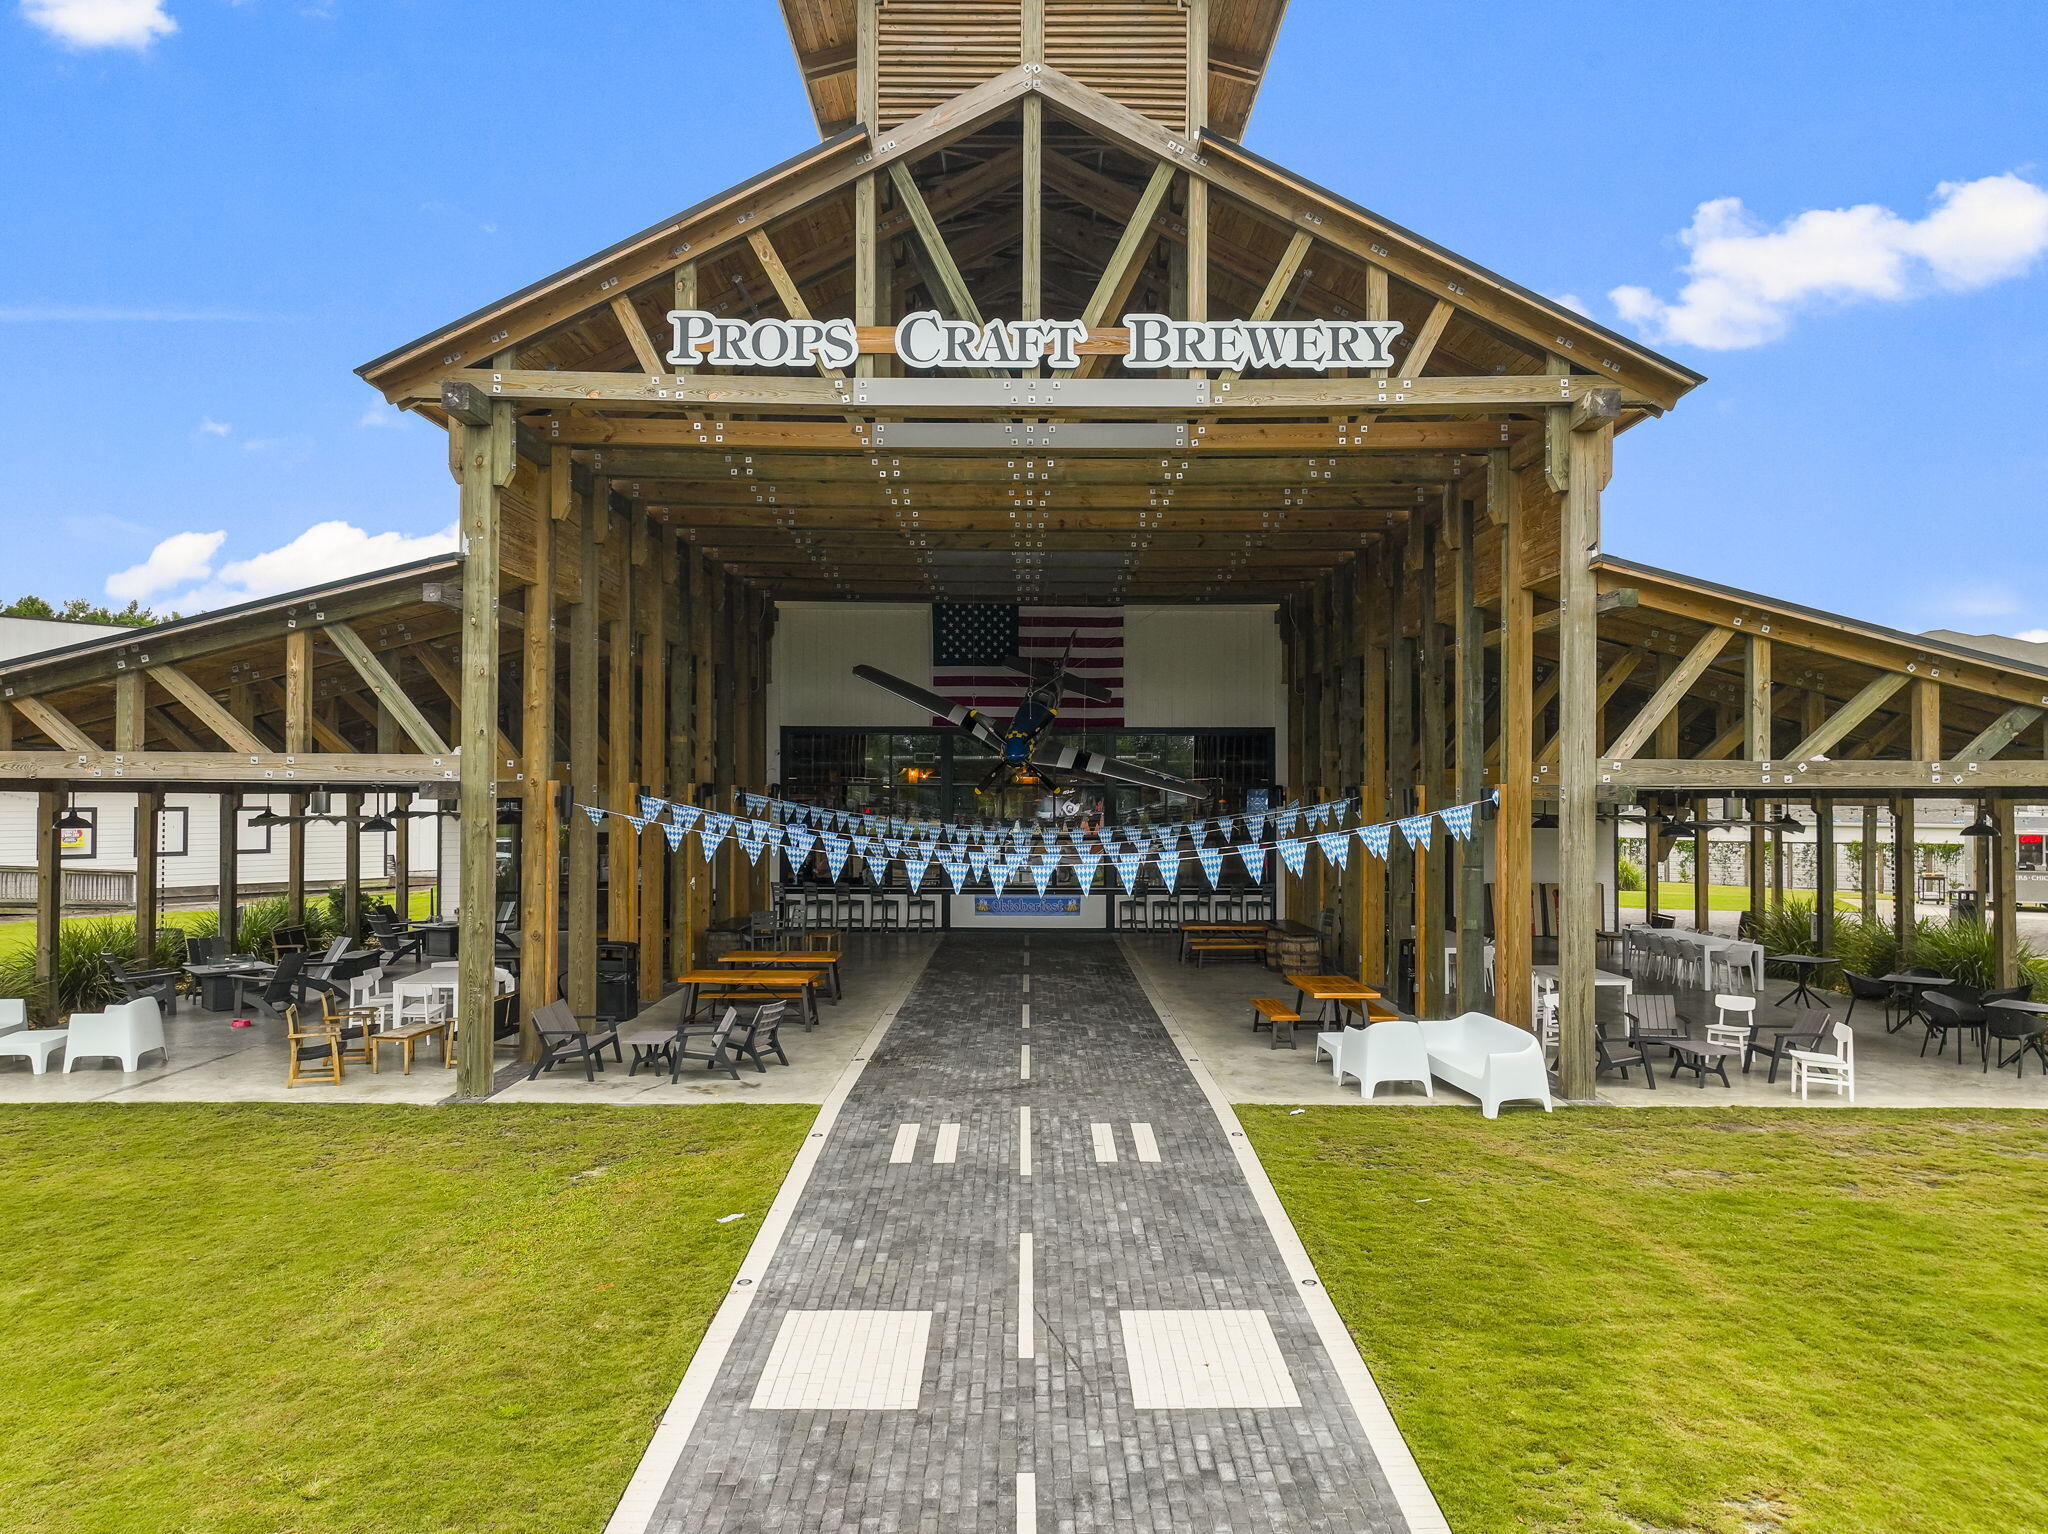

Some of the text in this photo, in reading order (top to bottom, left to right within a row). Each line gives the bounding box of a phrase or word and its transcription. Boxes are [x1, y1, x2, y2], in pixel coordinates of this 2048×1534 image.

[672, 316, 1398, 365] PROPS CRAFT BREWERY
[991, 898, 1065, 913] Oktoberfest
